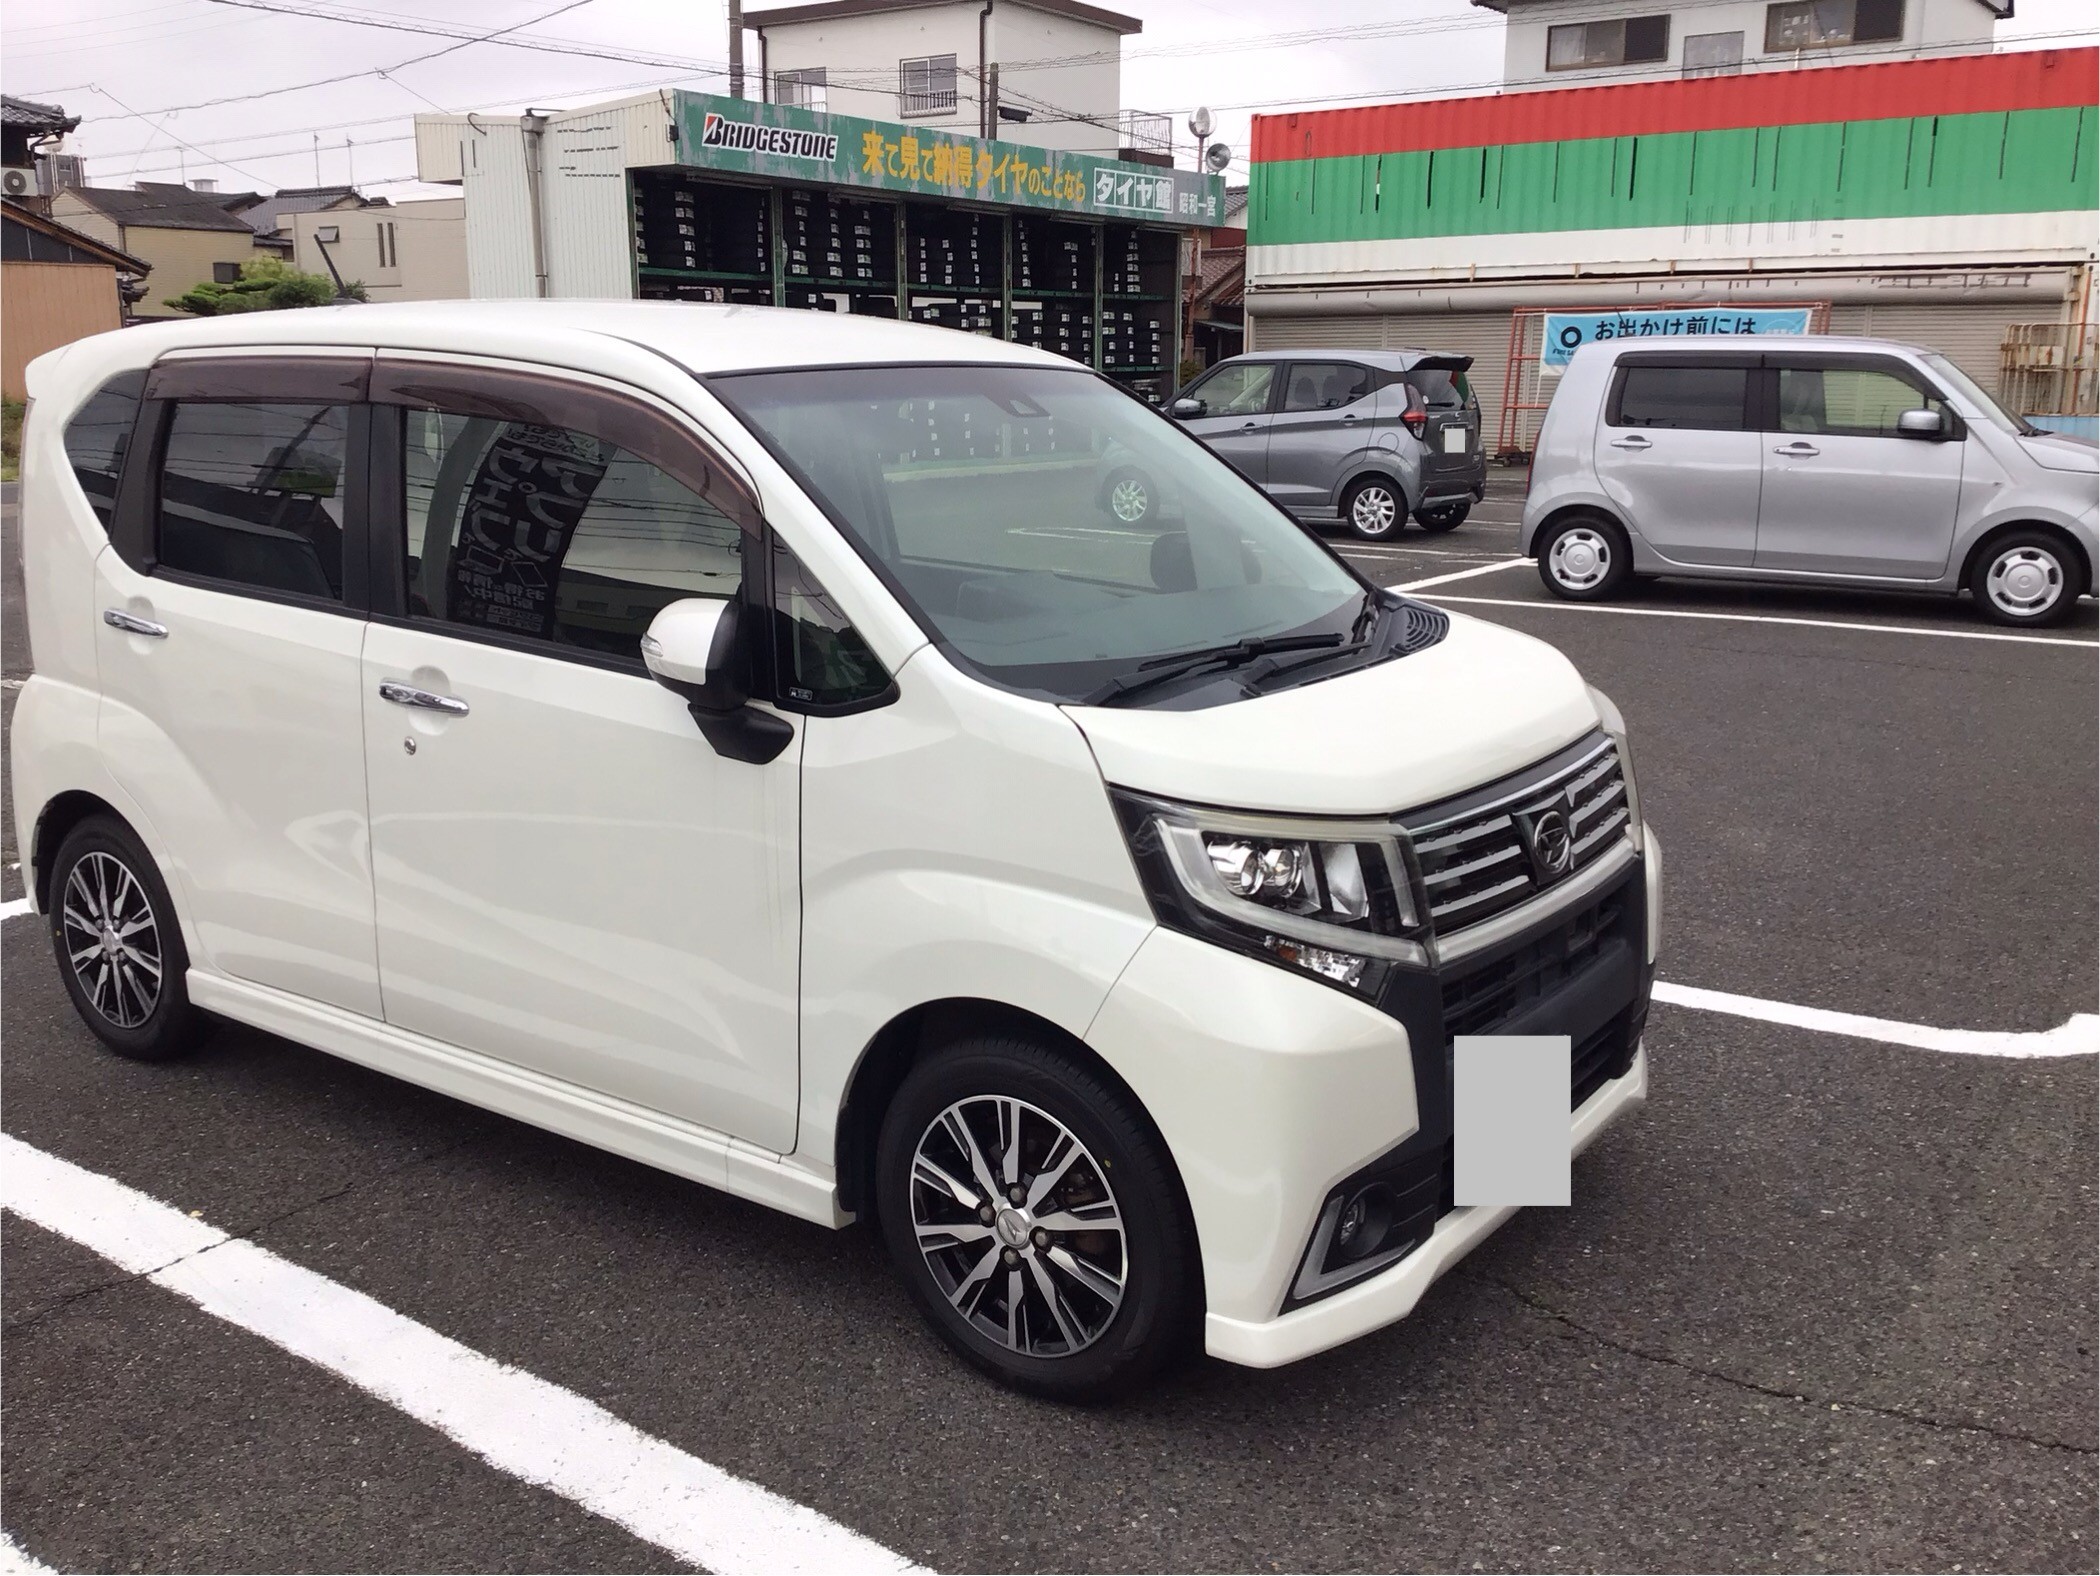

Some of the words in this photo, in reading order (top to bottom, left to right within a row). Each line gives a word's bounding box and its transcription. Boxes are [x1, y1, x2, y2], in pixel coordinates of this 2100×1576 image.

[703, 115, 836, 159] BRIDGESTONE
[862, 129, 1086, 202] 来て見て納得タイヤのことなら
[1096, 173, 1171, 210] タイヤ館
[1179, 192, 1217, 217] 昭和一宮
[1595, 316, 1757, 340] お出かけ前には
